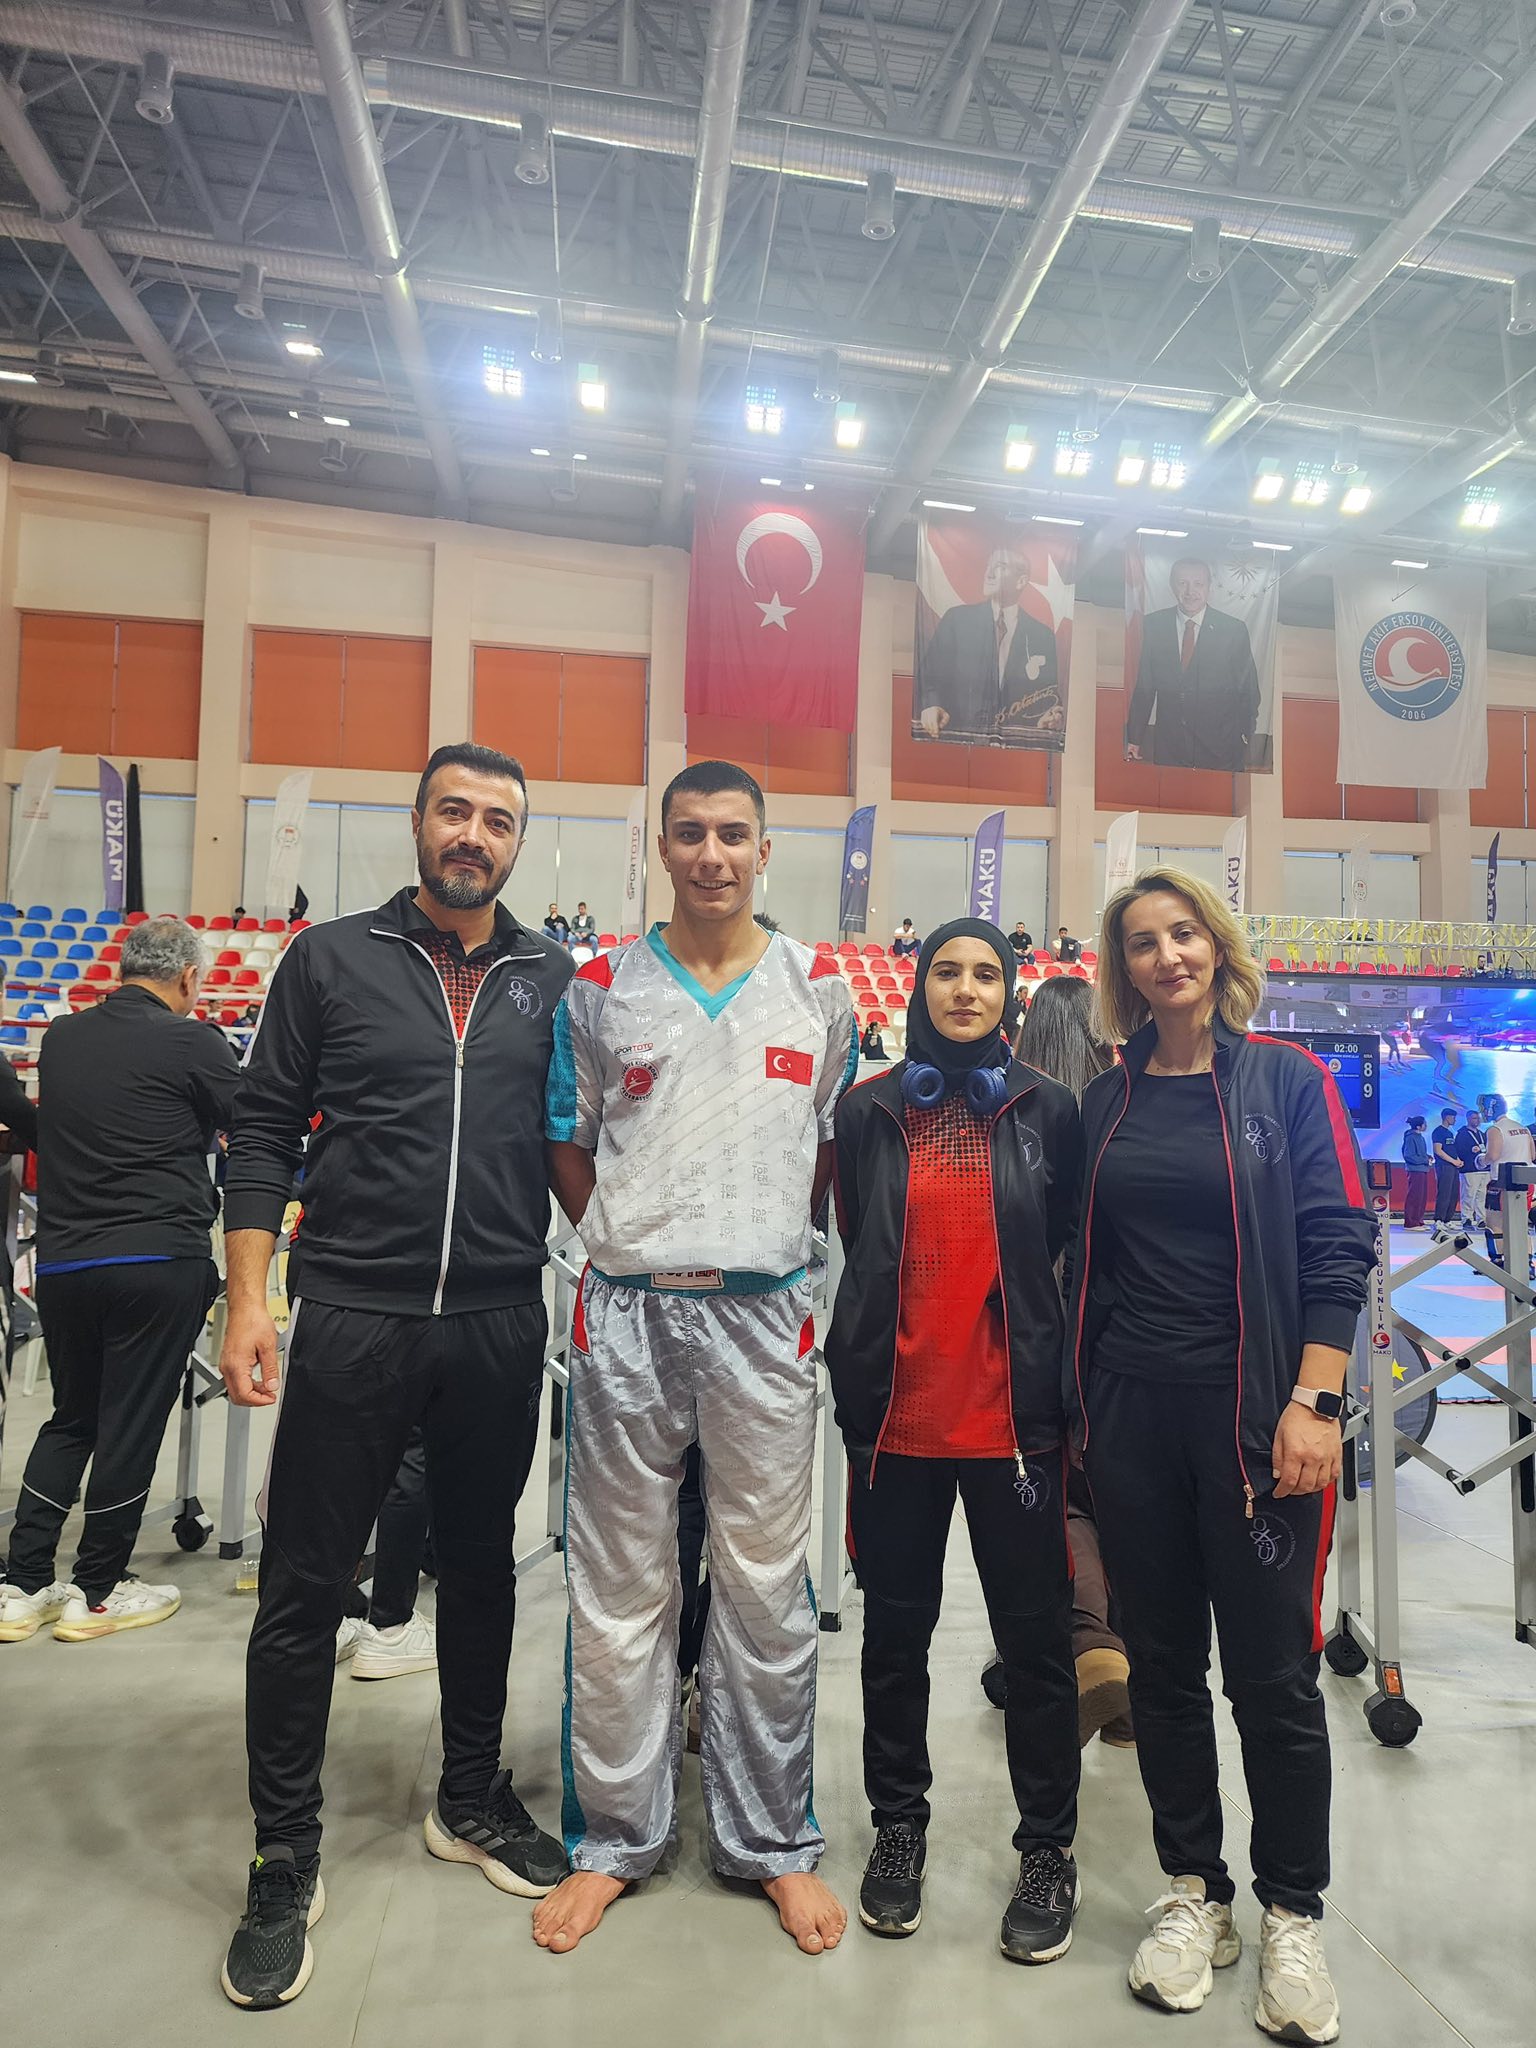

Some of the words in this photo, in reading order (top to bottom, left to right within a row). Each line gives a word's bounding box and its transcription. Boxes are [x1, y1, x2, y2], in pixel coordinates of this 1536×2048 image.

[1391, 614, 1426, 628] ERSOY
[1370, 621, 1390, 645] AKİF
[1362, 646, 1379, 692] MEHMET
[1401, 708, 1426, 720] 2006
[976, 848, 997, 921] MAKÜ
[1227, 856, 1241, 913] AKÜ
[1334, 1043, 1358, 1053] 02:00
[1363, 1062, 1373, 1077] 8
[1363, 1083, 1373, 1098] 9
[1376, 1262, 1385, 1331] GÜVENLİK
